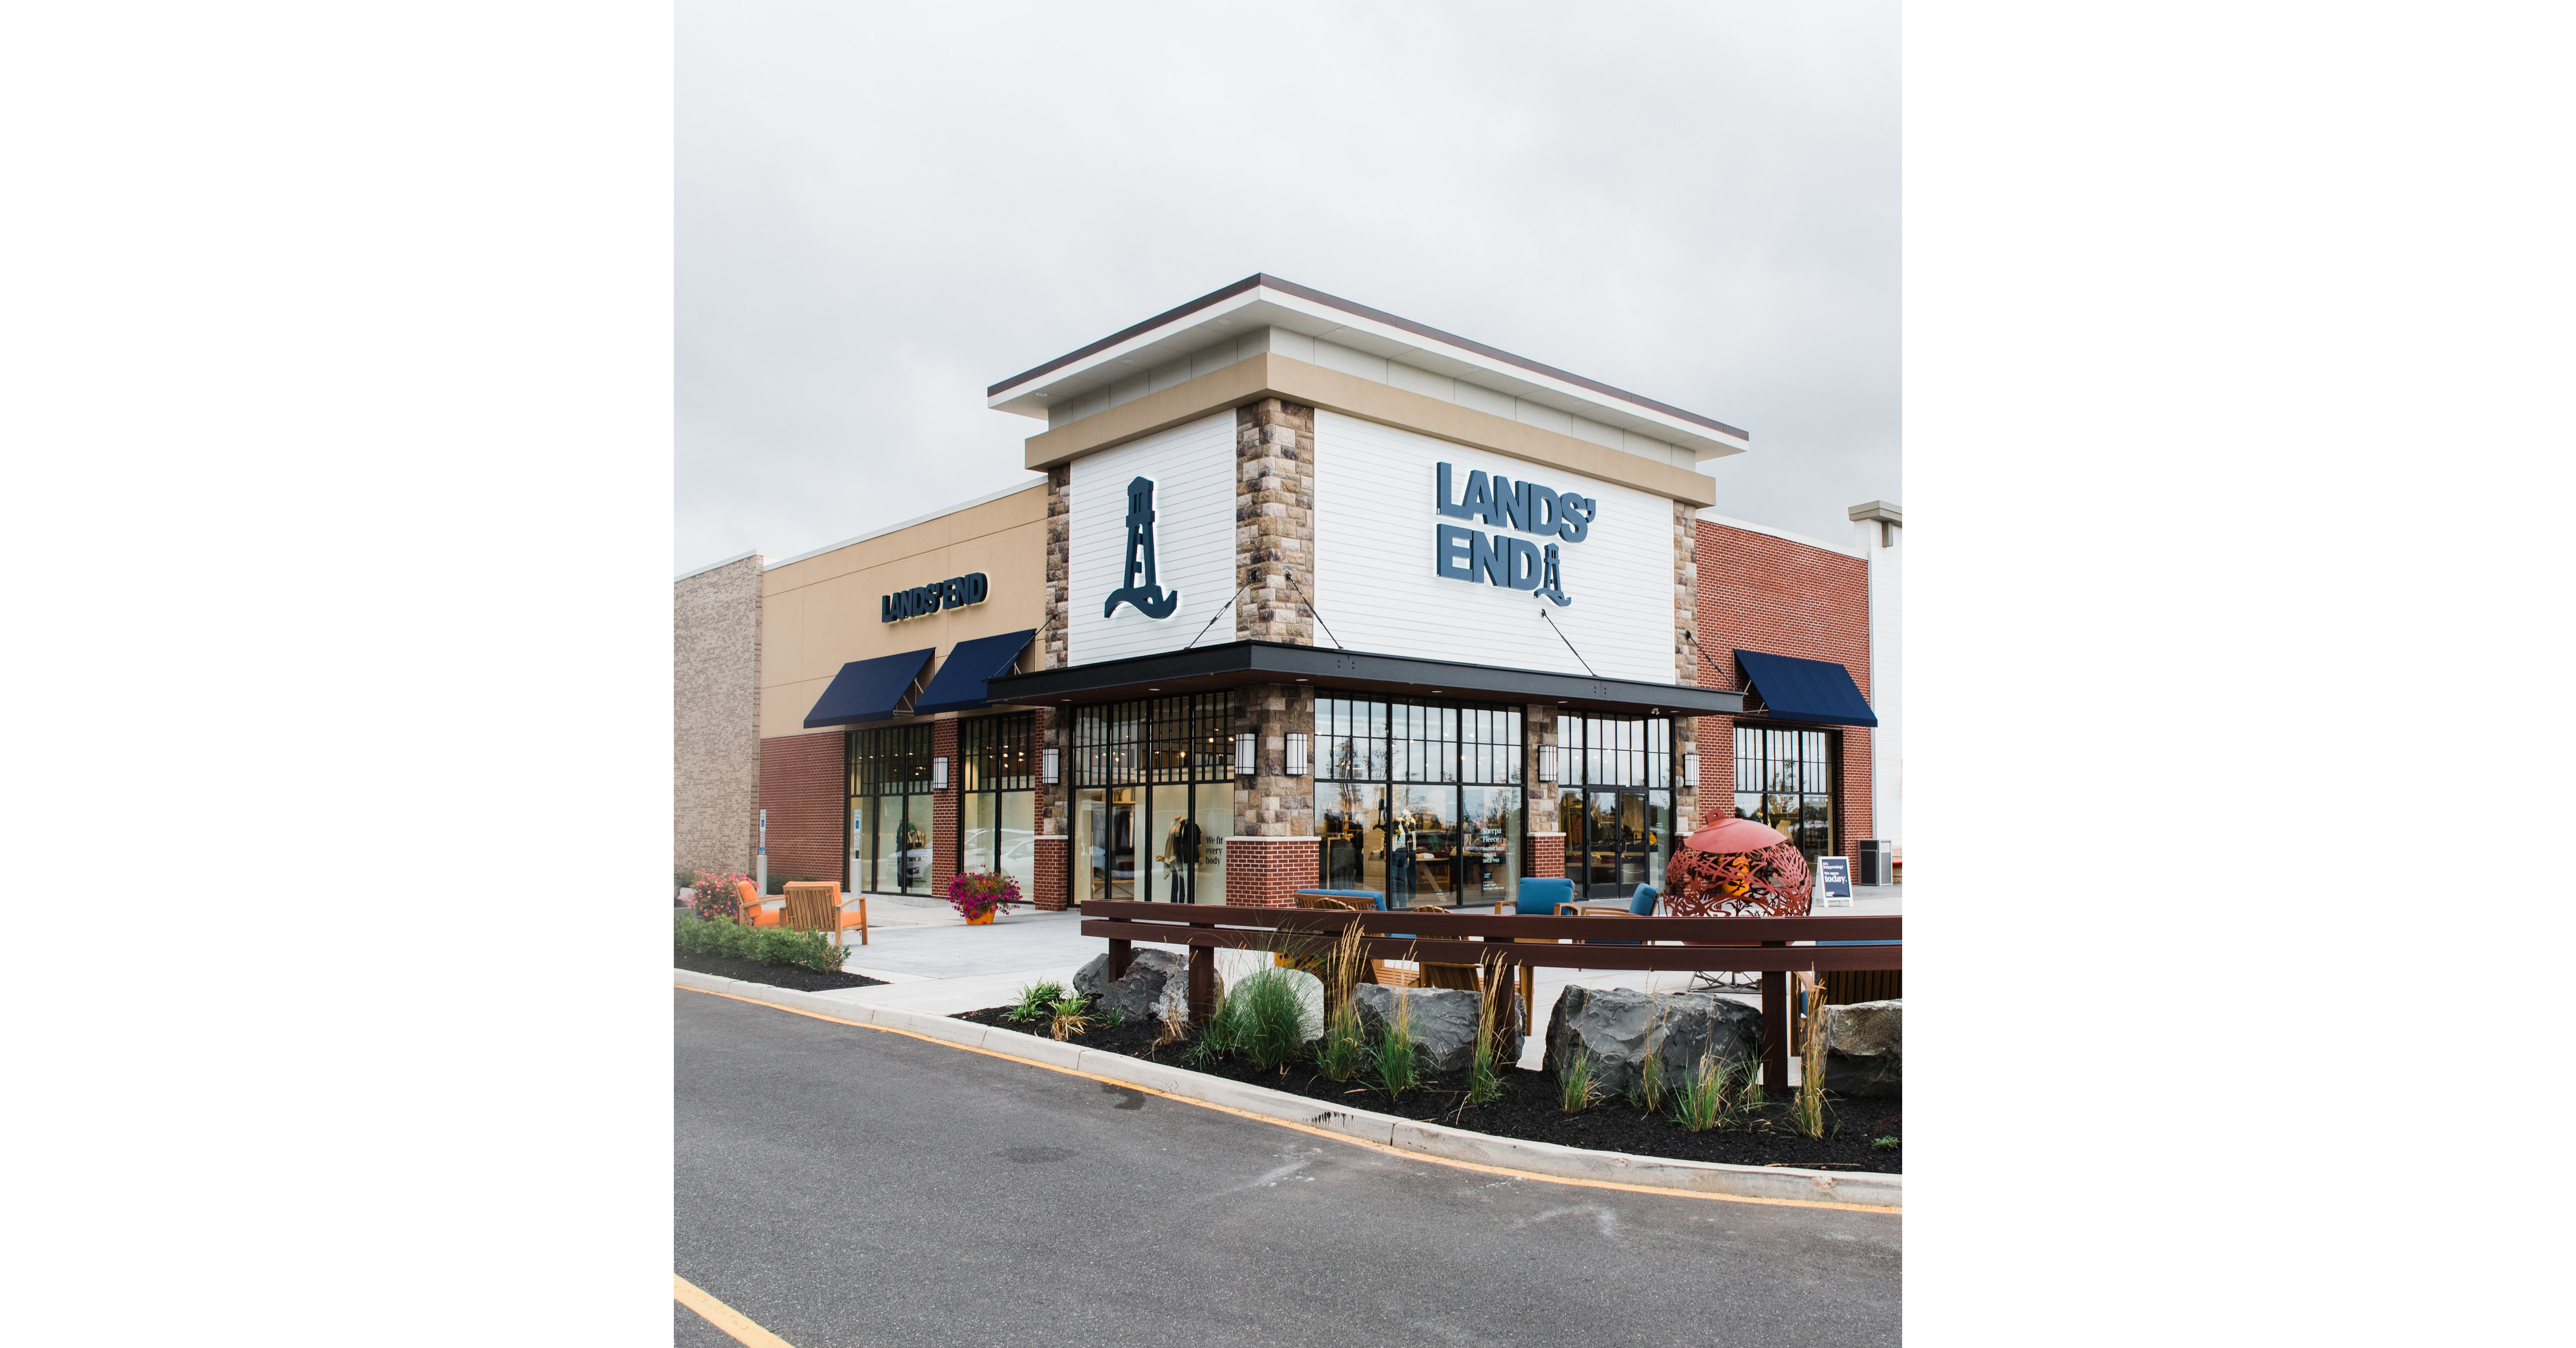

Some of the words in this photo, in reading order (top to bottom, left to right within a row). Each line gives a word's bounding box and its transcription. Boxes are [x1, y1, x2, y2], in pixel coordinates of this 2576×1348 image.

[1437, 462, 1596, 543] LANDS'
[1437, 523, 1542, 591] END
[882, 582, 944, 623] LANDS'
[943, 572, 988, 609] END
[1482, 827, 1502, 836] Sherpa
[1206, 848, 1223, 857] every
[1205, 857, 1221, 867] body
[1824, 875, 1847, 884] today.
